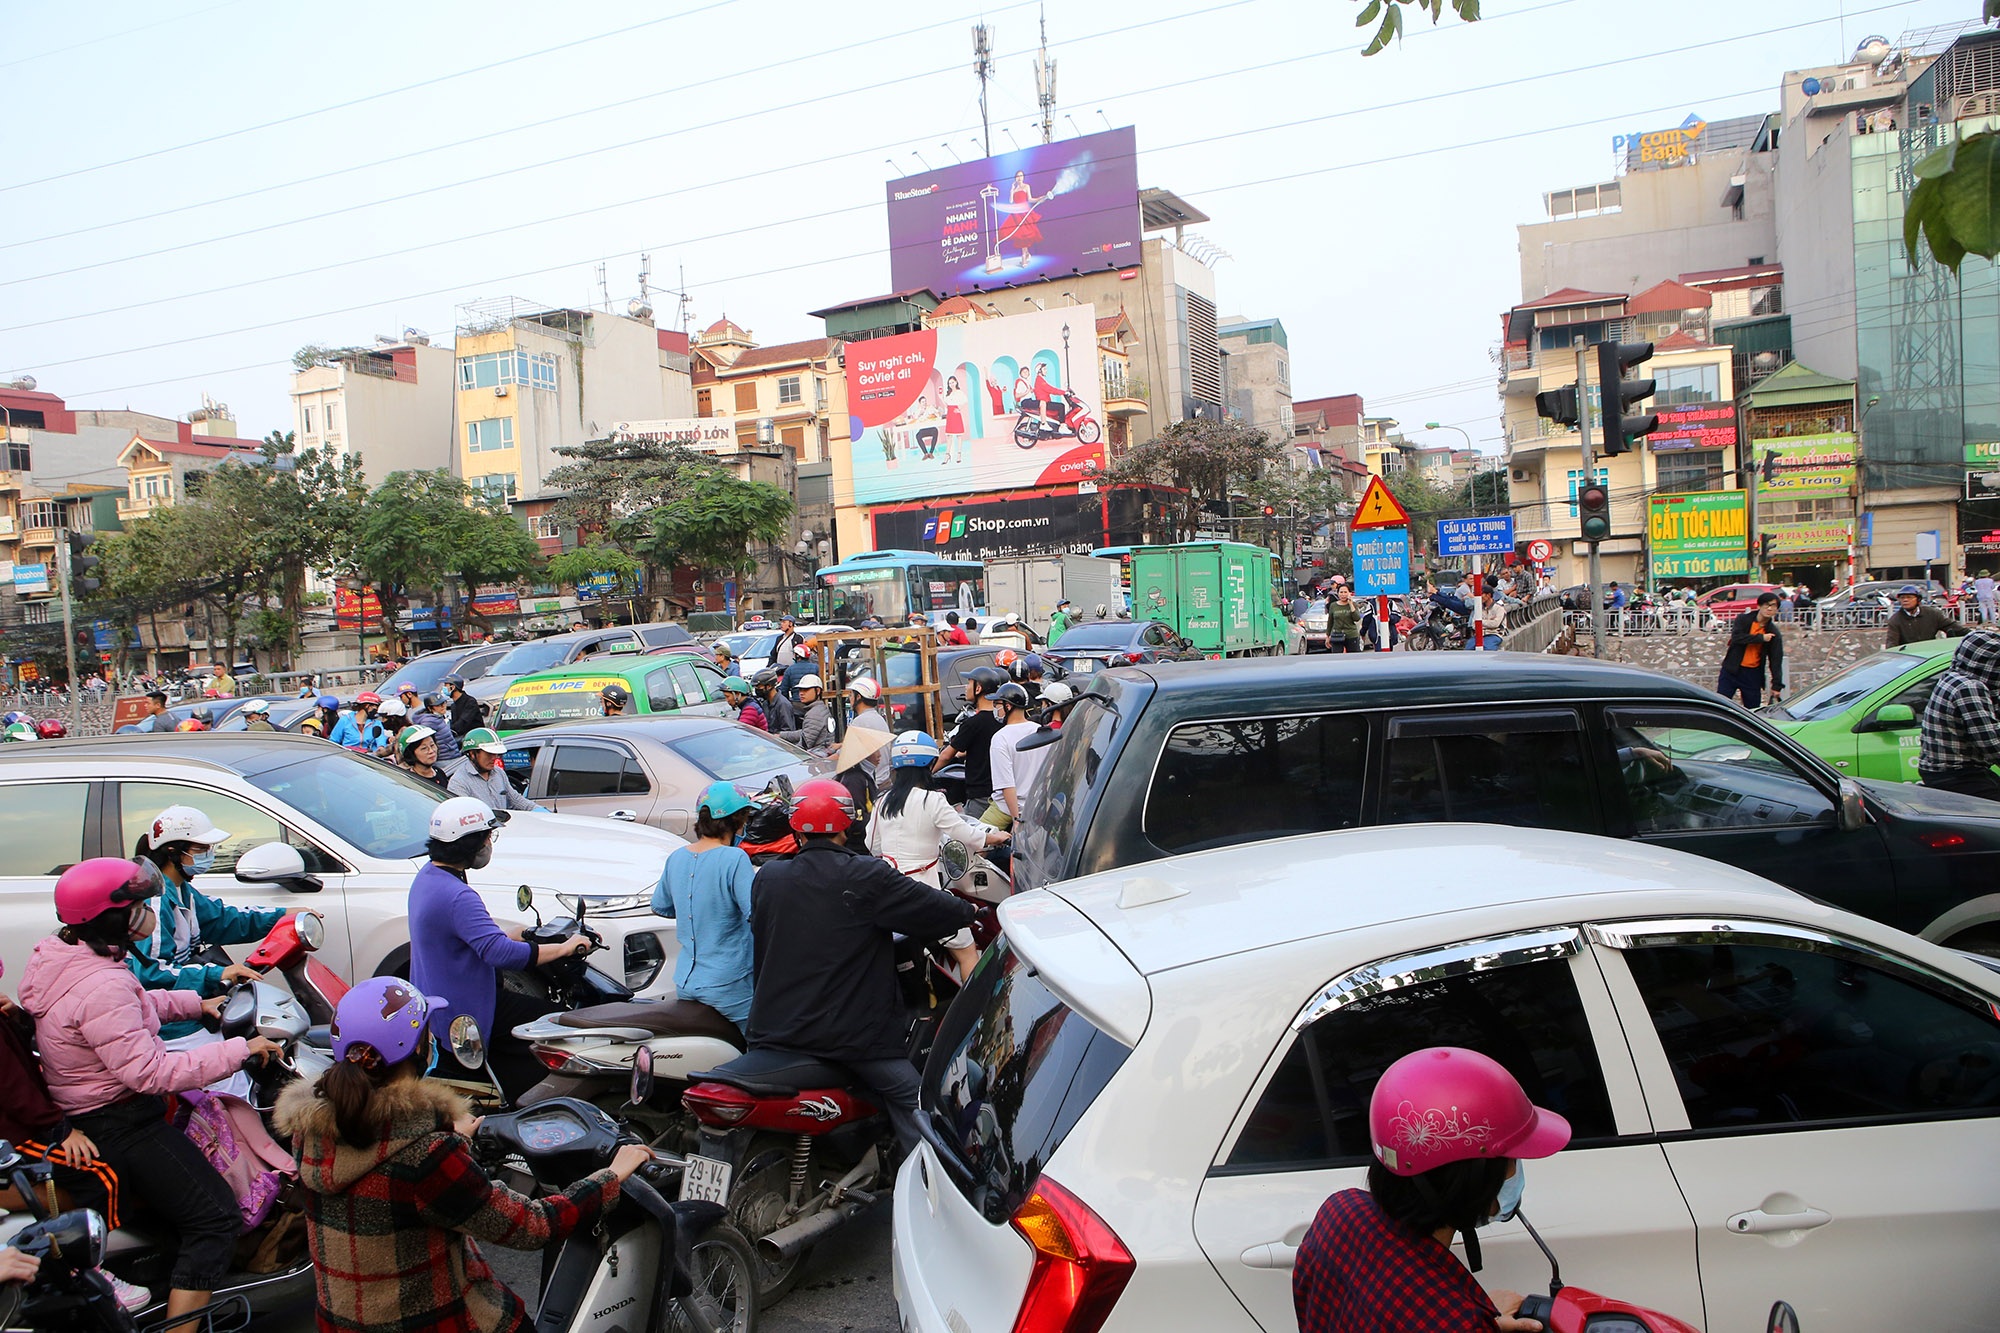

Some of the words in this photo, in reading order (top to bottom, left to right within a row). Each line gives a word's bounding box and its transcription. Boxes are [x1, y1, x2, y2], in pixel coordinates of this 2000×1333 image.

[1641, 142, 1689, 162] Bank
[946, 210, 977, 224] NHANH
[858, 361, 876, 372] Suy
[880, 356, 902, 370] nghĩ
[859, 371, 894, 384] GoViet
[898, 368, 911, 380] đi!
[676, 424, 702, 440] KHỔ
[704, 425, 730, 440] LỚN
[1701, 434, 1736, 446] GOSS
[969, 516, 1050, 533] Shop.com.vn
[1462, 522, 1476, 534] LẠC
[1479, 520, 1506, 532] TRUNG
[1653, 504, 1679, 540] CẮT
[1681, 505, 1709, 538] TÓC
[1710, 508, 1744, 538] NAM
[1386, 542, 1404, 554] CAO
[1362, 558, 1374, 571] AN
[1377, 555, 1402, 570] TOÀN
[1653, 556, 1680, 574] CẮT
[1683, 557, 1710, 574] TÓC
[1714, 558, 1748, 572] NAM
[1368, 573, 1396, 587] 4,75M
[549, 681, 585, 690] MPE
[508, 696, 525, 706] 2579
[593, 1296, 636, 1320] HONDA
